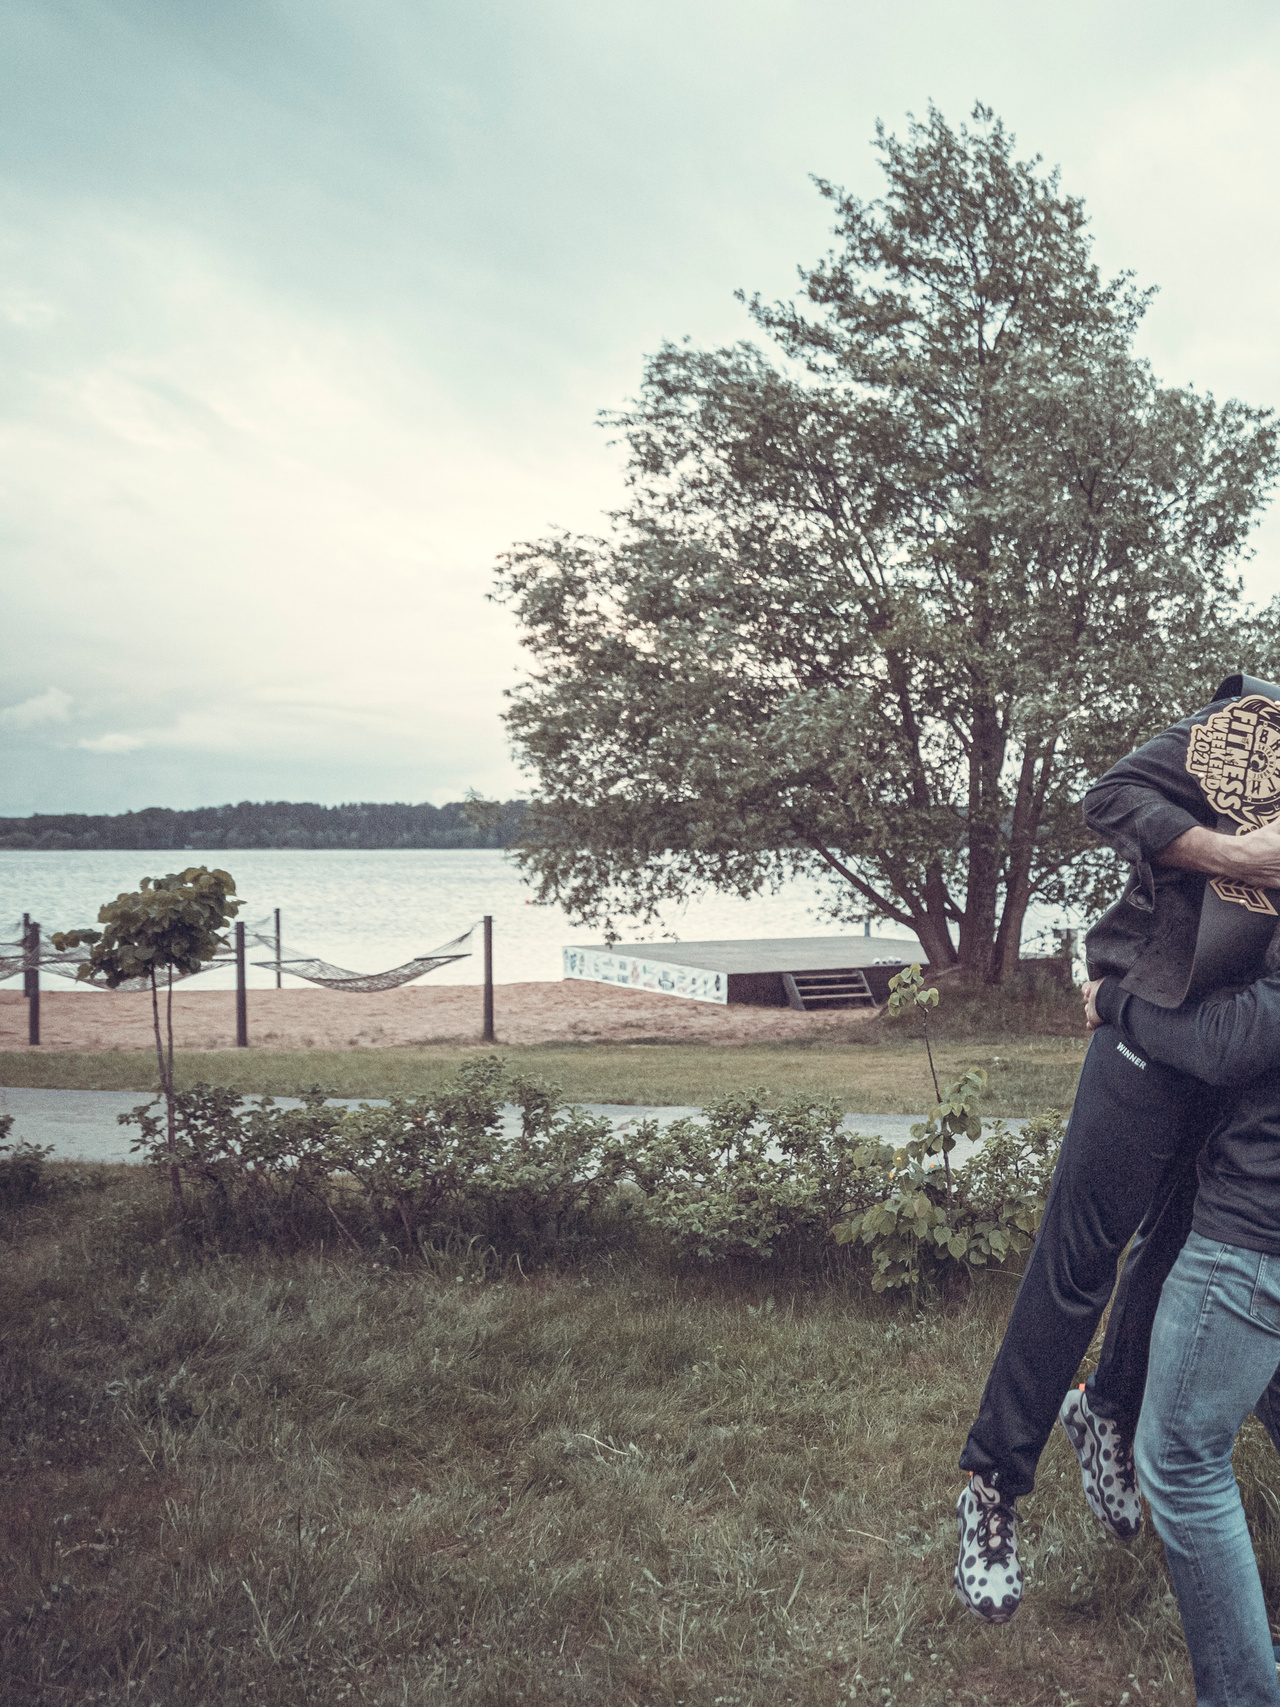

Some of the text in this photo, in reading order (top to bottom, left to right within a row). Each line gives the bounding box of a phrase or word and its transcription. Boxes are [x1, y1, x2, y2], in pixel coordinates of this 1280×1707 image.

[1190, 729, 1213, 773] 2021
[1206, 718, 1230, 790] WEEKEND
[1217, 709, 1258, 810] FITNESS
[1116, 1042, 1147, 1070] WINNER
